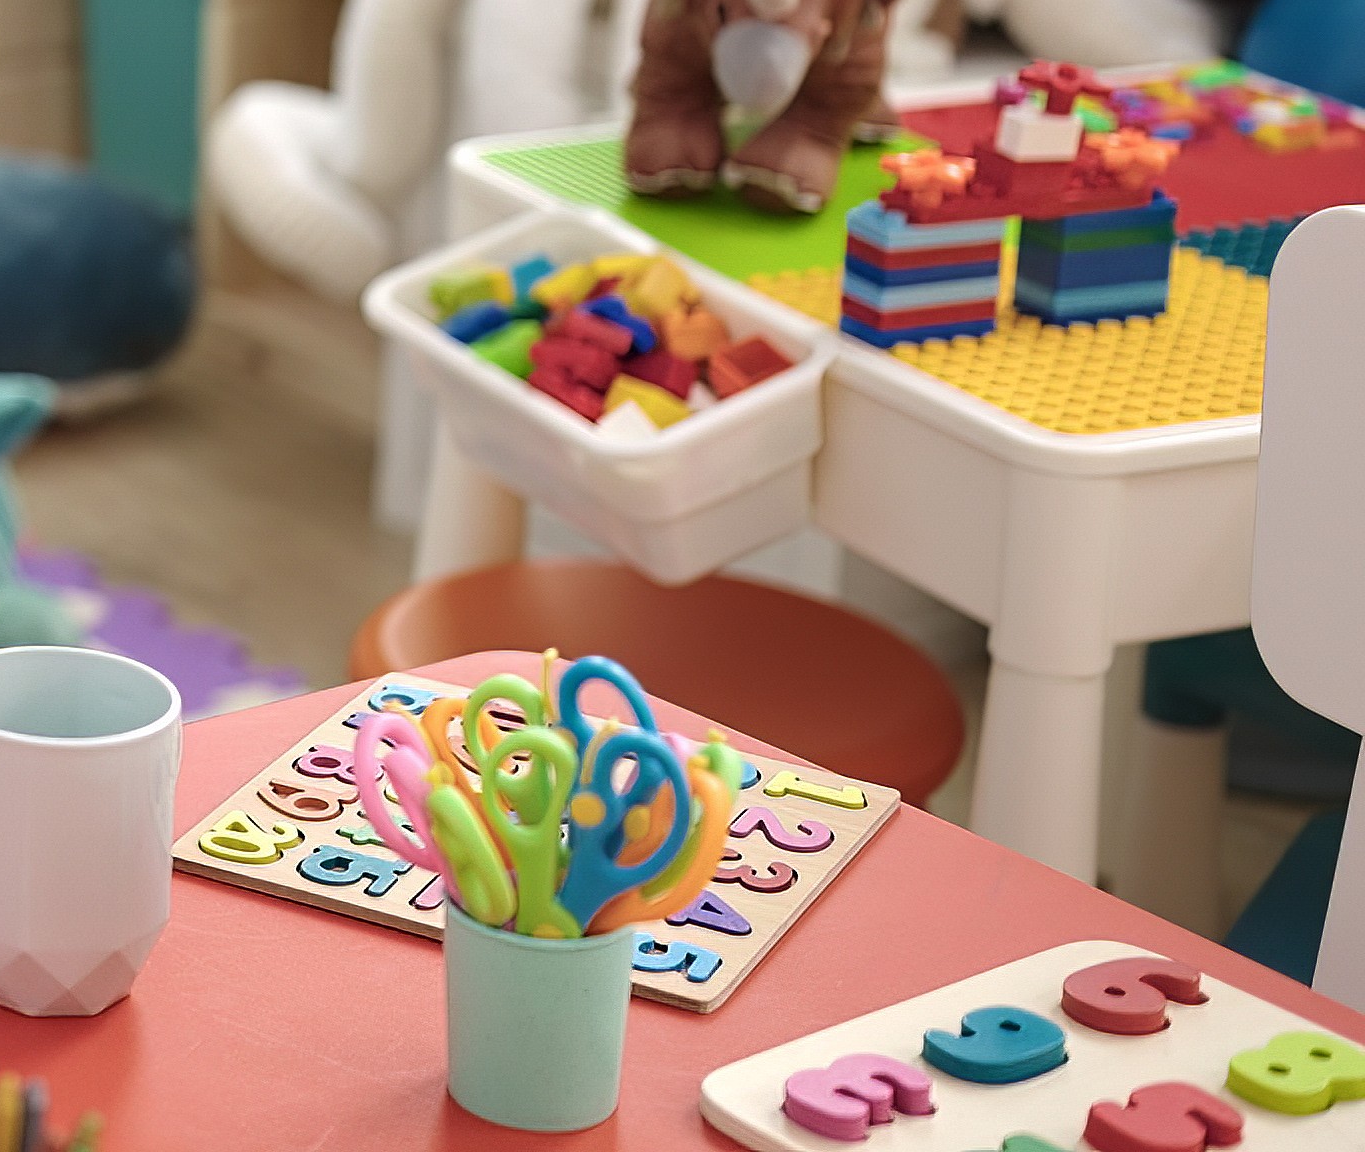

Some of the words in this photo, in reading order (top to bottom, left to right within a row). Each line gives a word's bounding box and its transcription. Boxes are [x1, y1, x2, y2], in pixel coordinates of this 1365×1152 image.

[763, 771, 868, 810] 1
[198, 810, 305, 865] 20
[730, 806, 835, 853] 2
[711, 848, 799, 894] 3
[666, 890, 752, 935] 4
[632, 932, 723, 983] 5
[782, 1053, 936, 1140] 3
[1225, 1030, 1365, 1116] 8
